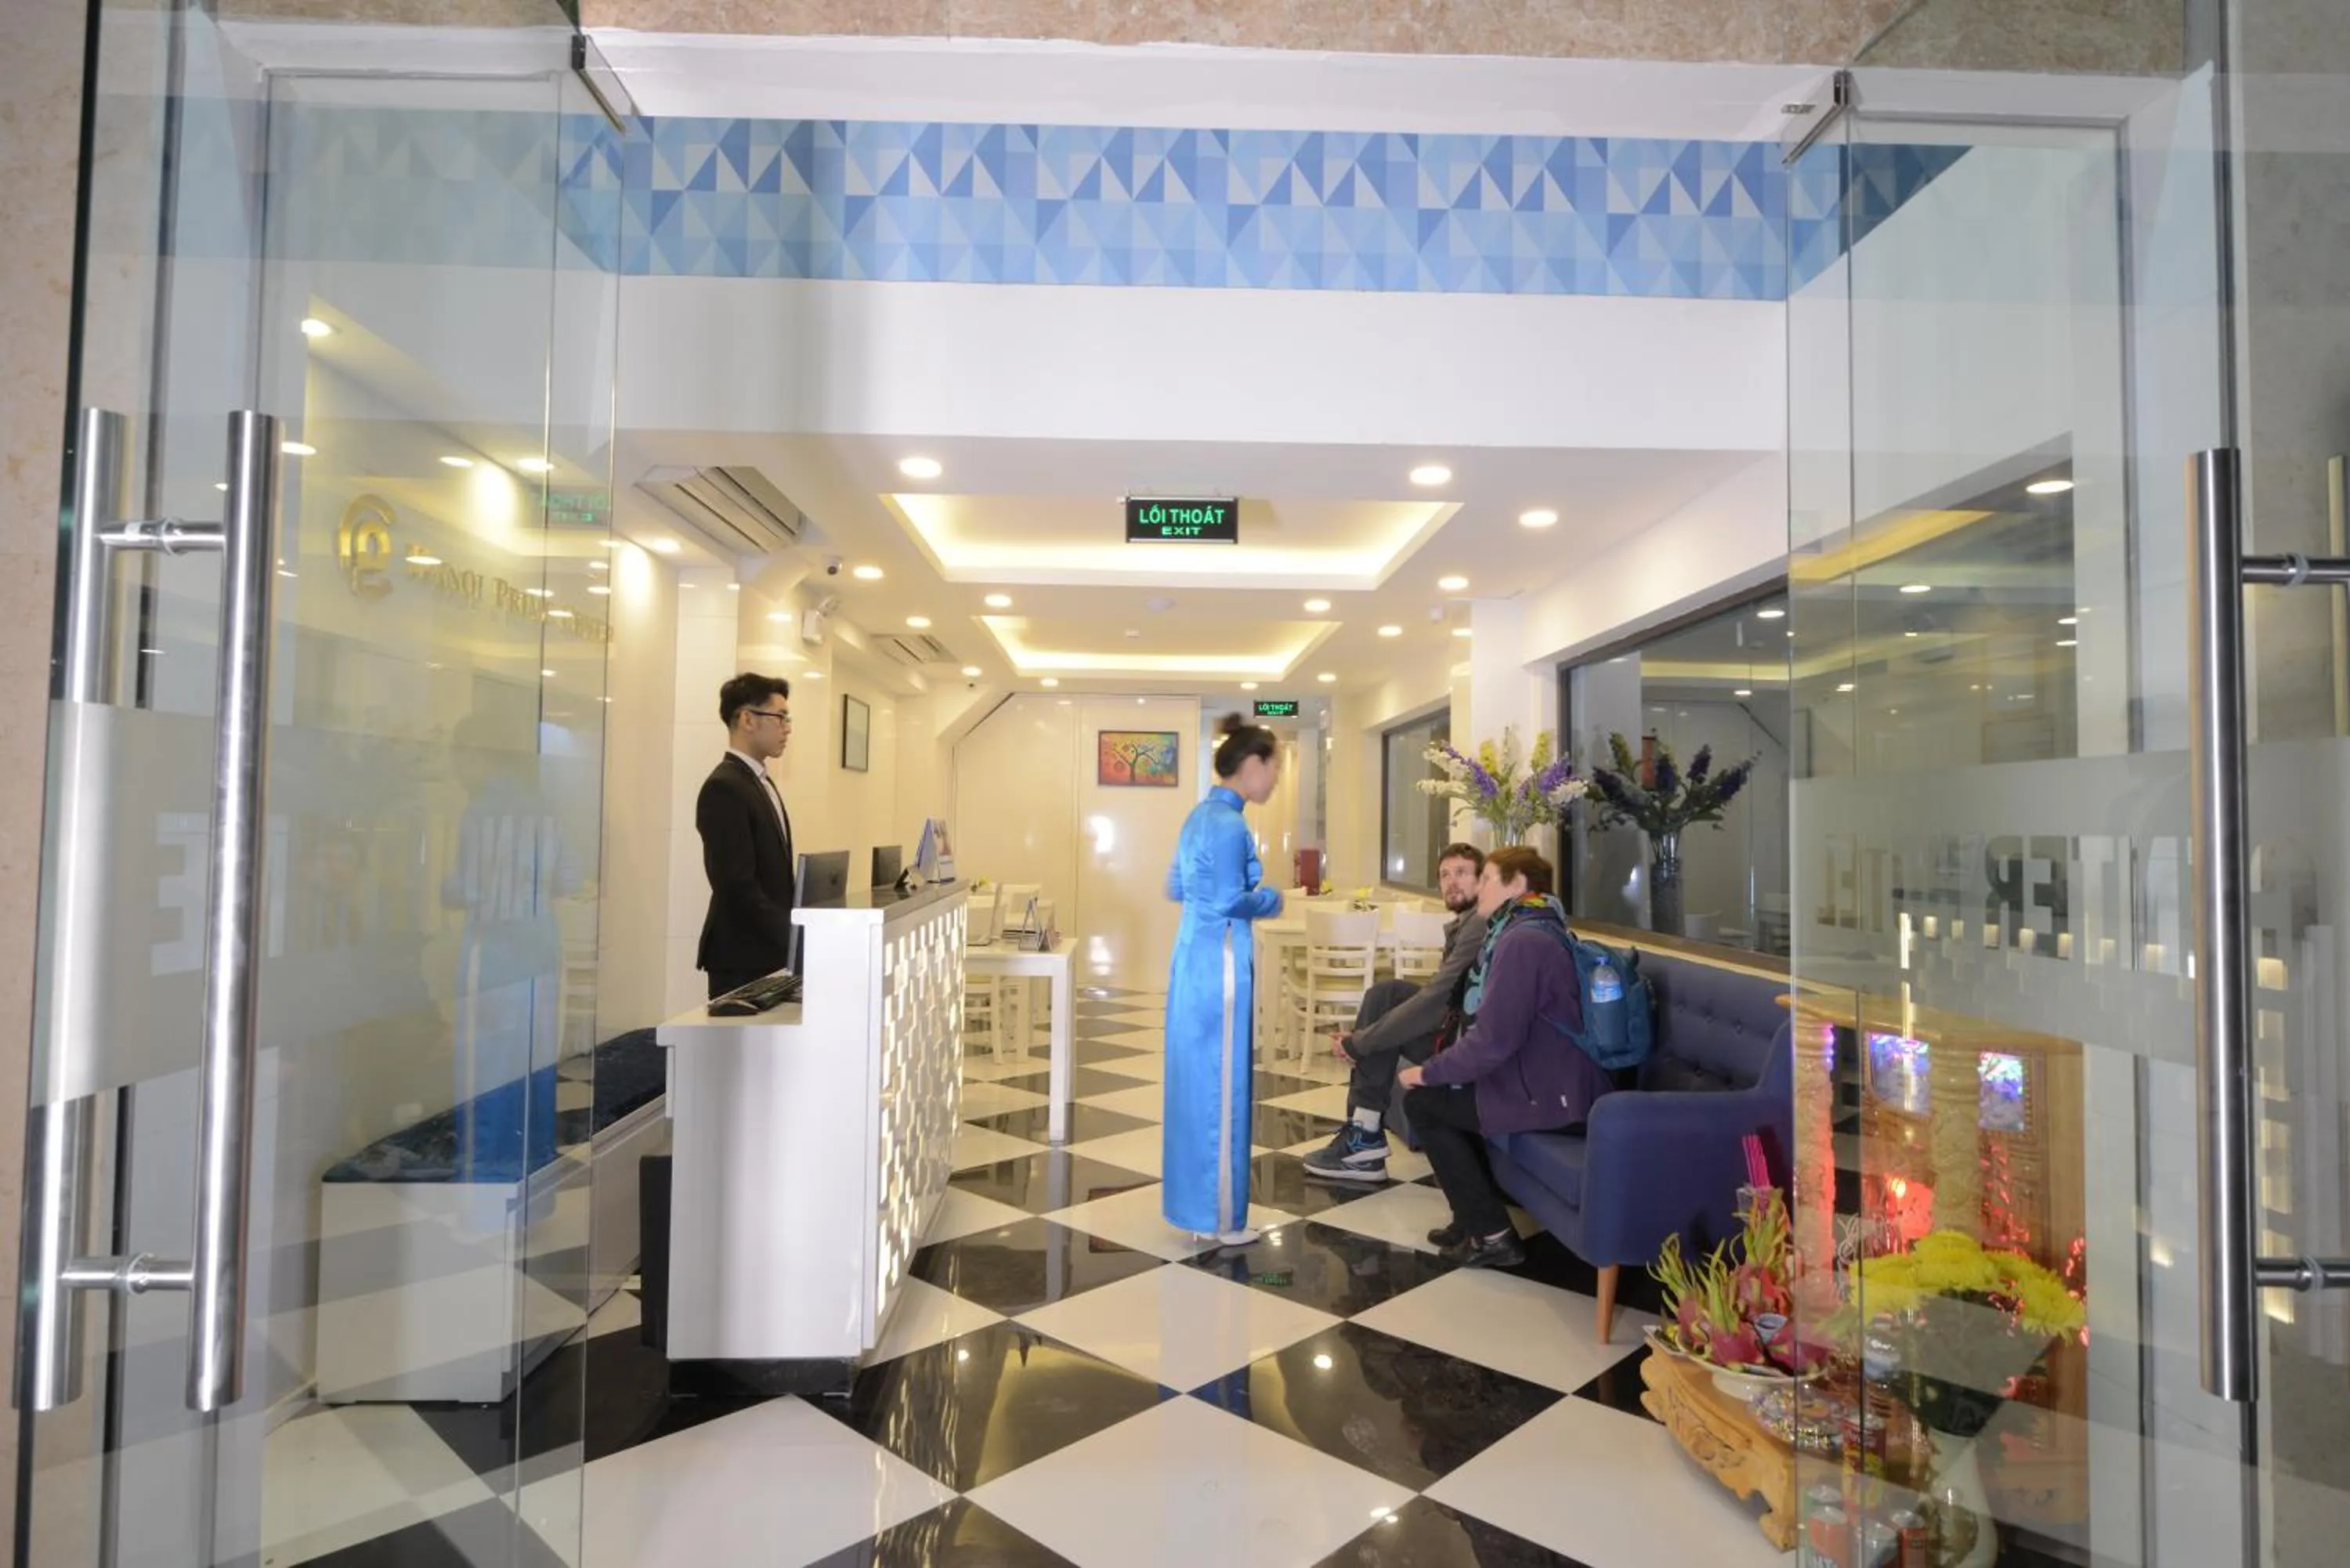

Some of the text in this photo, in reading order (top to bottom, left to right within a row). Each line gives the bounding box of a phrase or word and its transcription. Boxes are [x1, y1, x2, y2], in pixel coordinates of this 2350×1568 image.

[1139, 504, 1224, 524] LỐI THOÁT
[1162, 526, 1202, 536] EXIT
